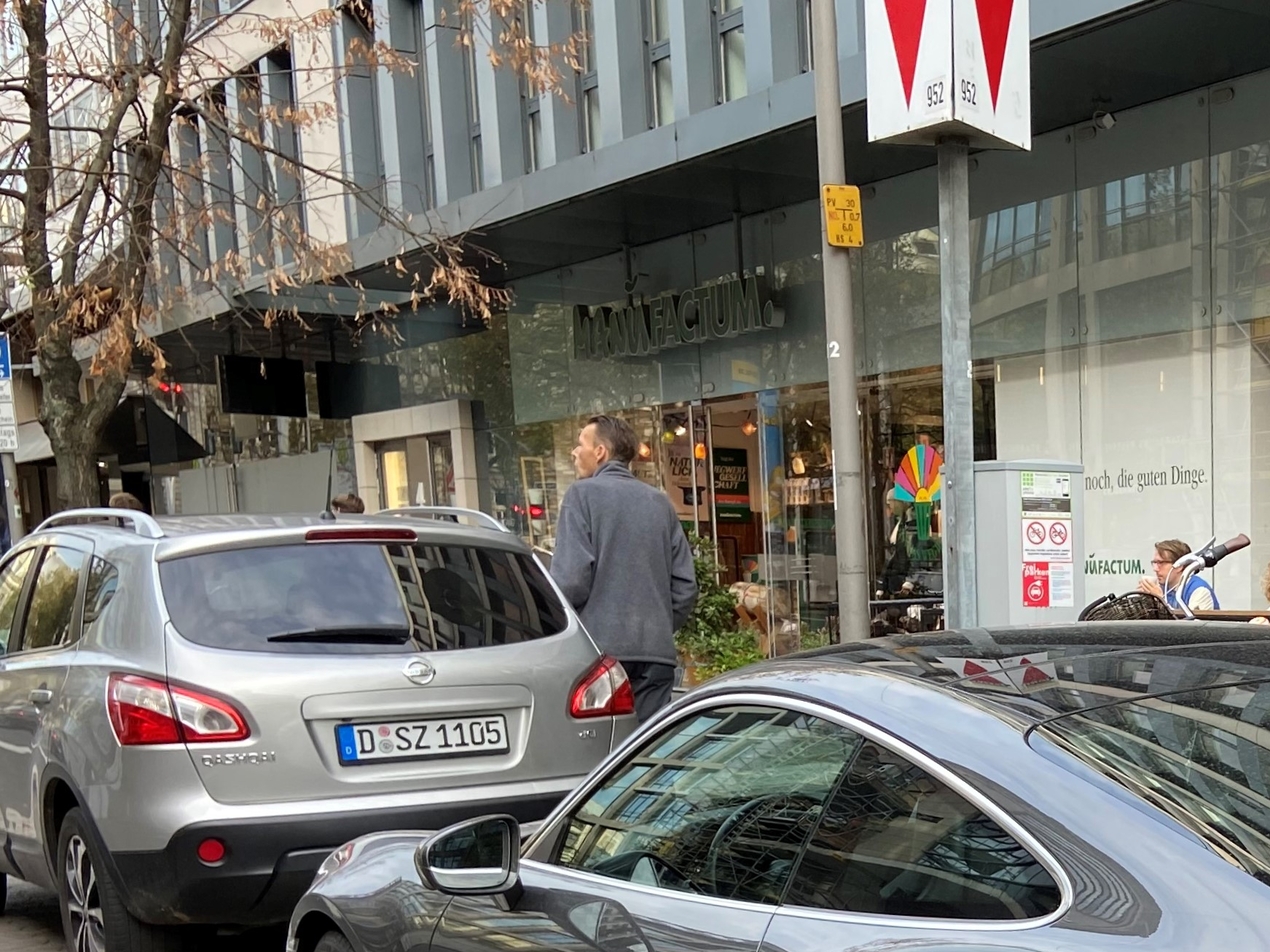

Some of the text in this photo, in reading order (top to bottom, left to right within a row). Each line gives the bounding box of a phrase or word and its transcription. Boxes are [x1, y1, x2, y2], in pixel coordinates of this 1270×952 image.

[926, 81, 944, 108] 952
[961, 78, 977, 106] 952
[1084, 465, 1208, 493] noch, die guten Dinge.
[357, 729, 375, 754] D
[395, 725, 431, 751] SZ
[436, 720, 501, 748] 1105
